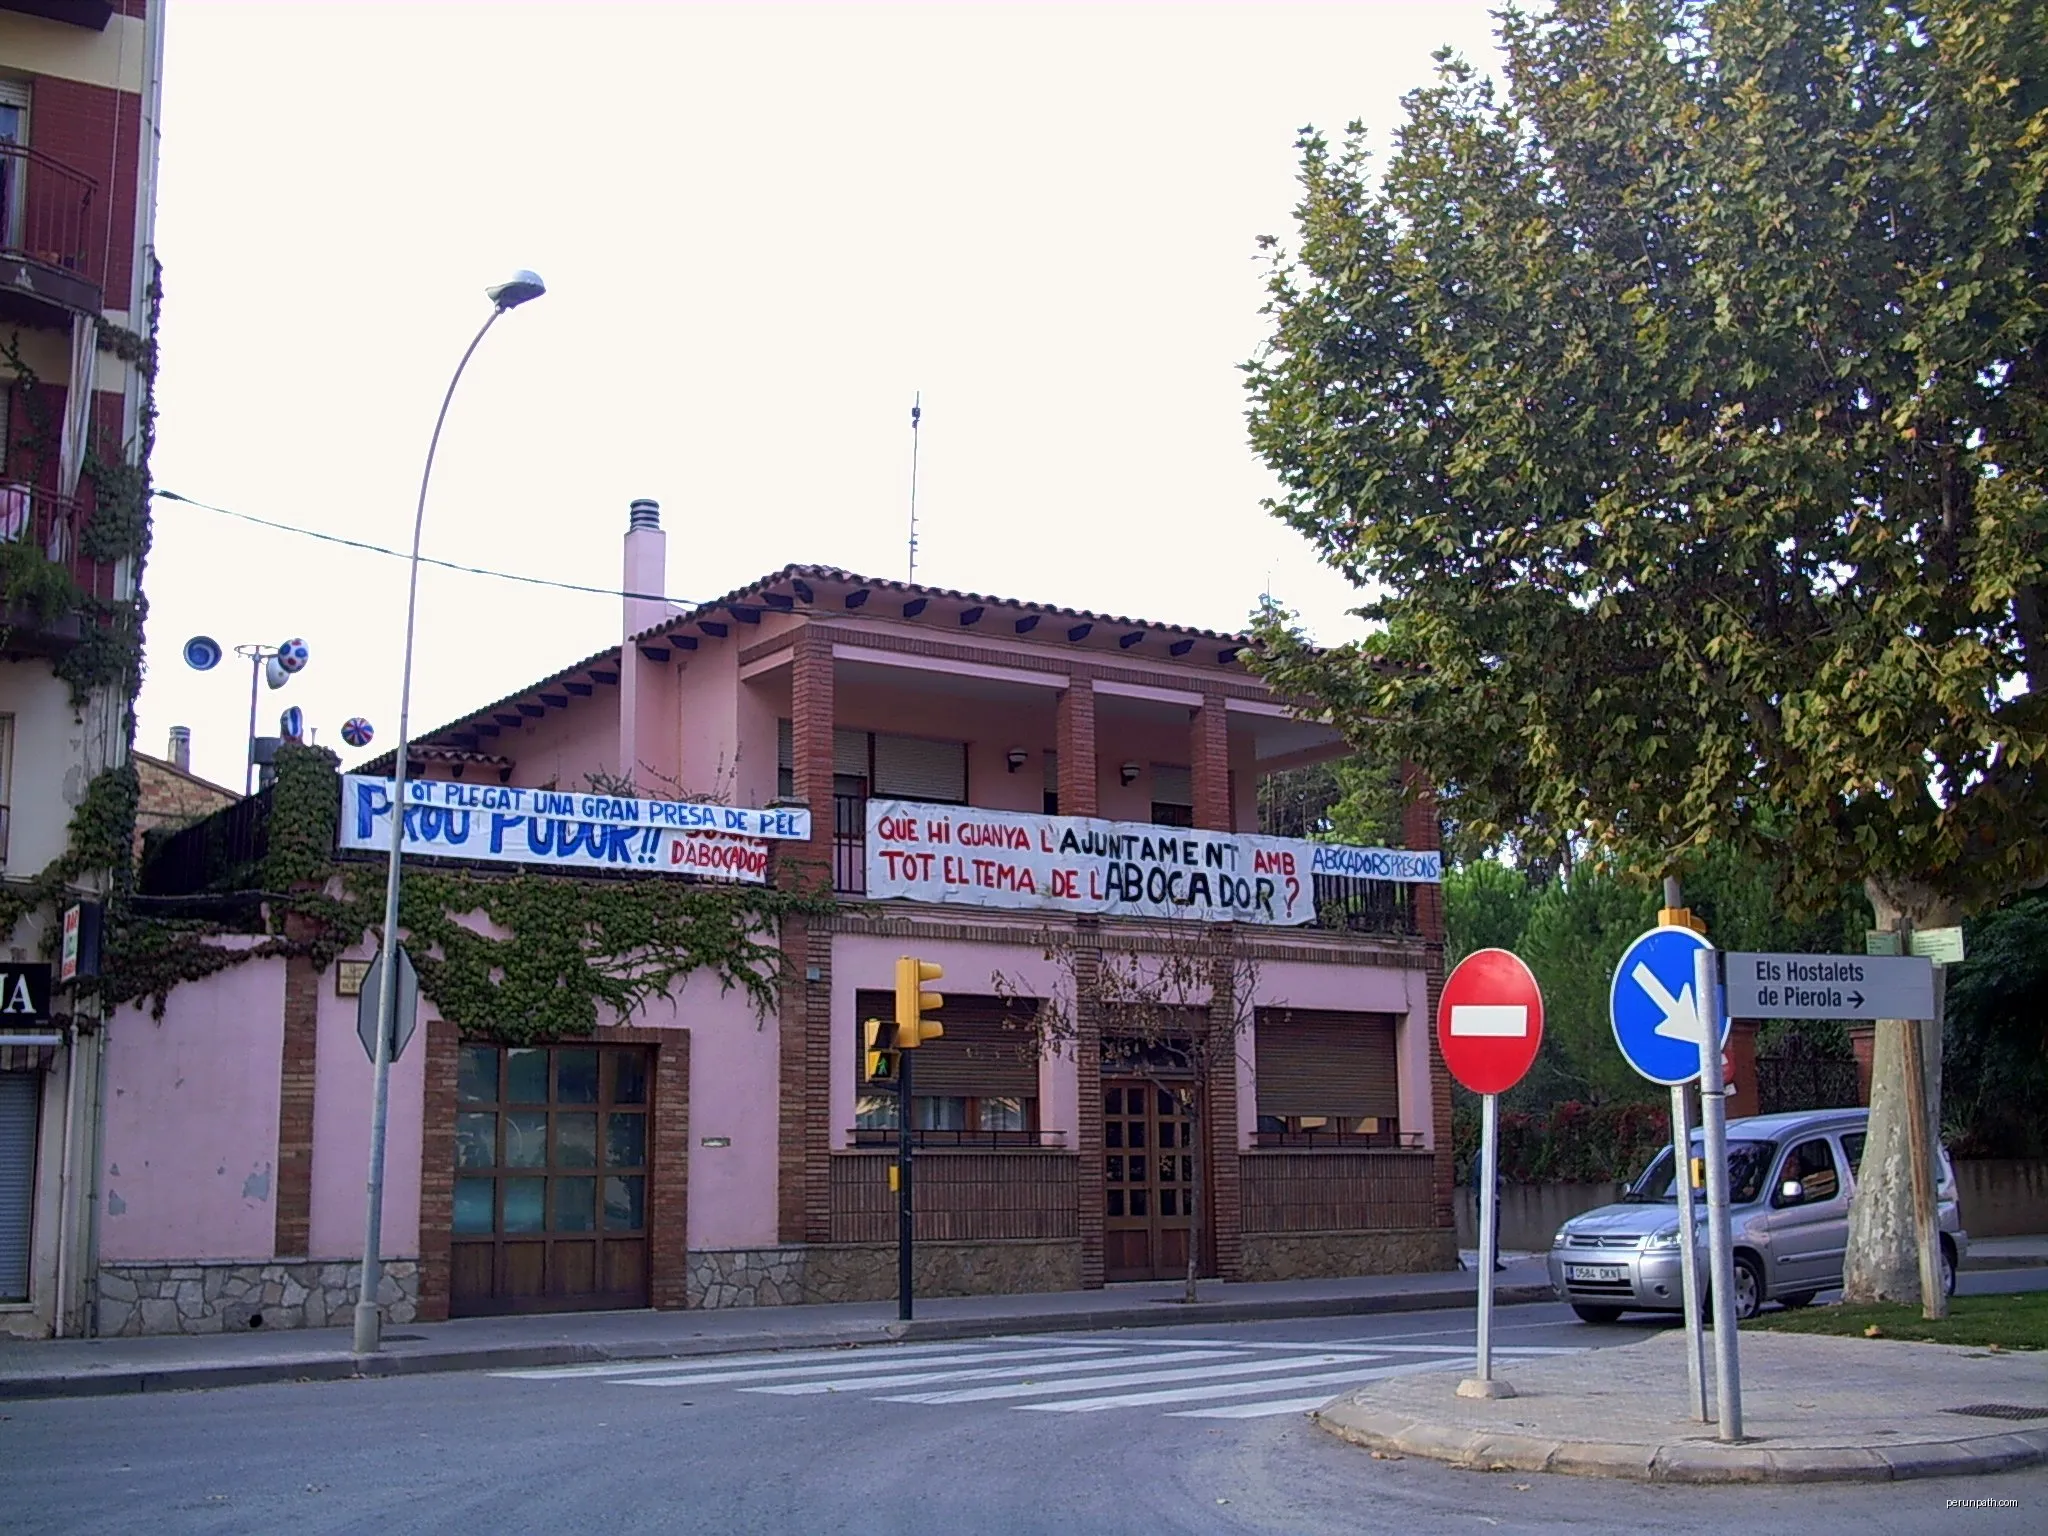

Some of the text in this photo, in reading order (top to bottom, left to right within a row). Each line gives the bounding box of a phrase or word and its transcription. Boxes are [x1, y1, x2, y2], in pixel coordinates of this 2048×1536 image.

[446, 784, 526, 810] PLEGAT
[534, 792, 574, 816] UNA
[582, 798, 638, 821] GRAN
[650, 802, 717, 826] PRESA
[725, 810, 748, 831] DE
[760, 809, 800, 835] PÈL
[878, 809, 919, 842] QUÈ
[957, 823, 1030, 850] GUANYA
[1254, 849, 1295, 876] AMB
[879, 851, 936, 881] TOT
[944, 856, 969, 884] EL
[972, 859, 1036, 895] TEMA
[1052, 869, 1081, 899] DE
[1756, 961, 1864, 981] Els Hostalets
[1758, 986, 1842, 1006] de Pierola
